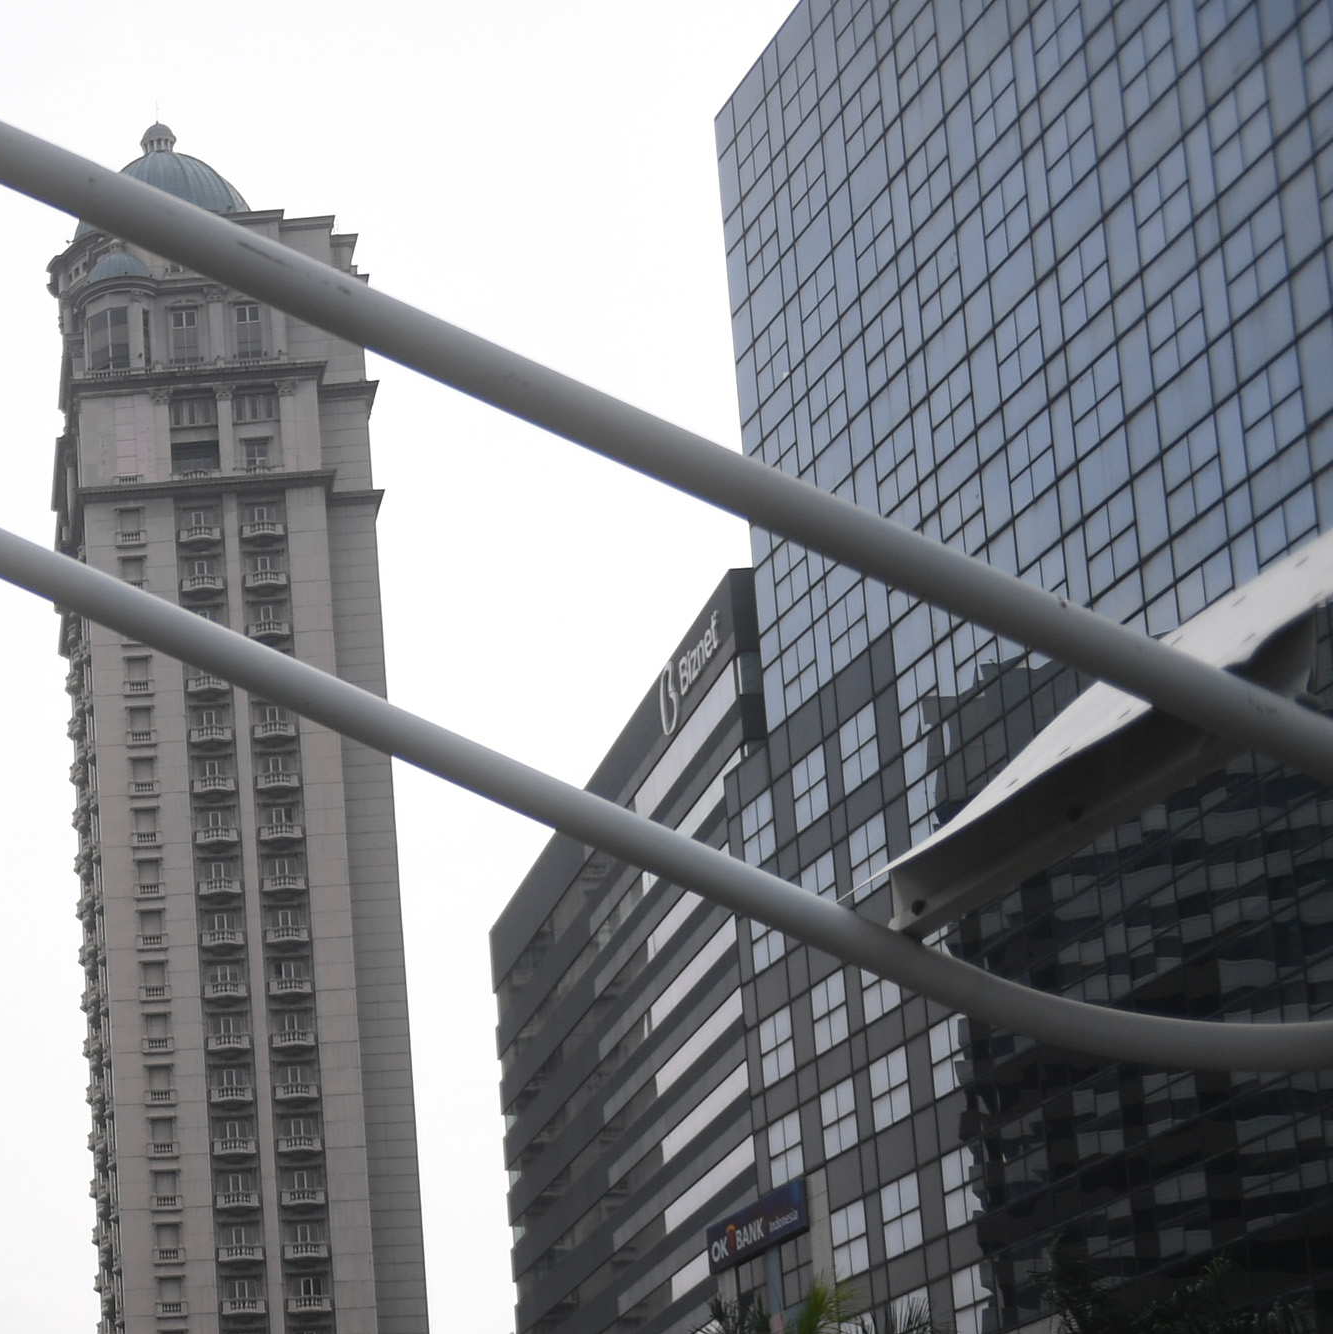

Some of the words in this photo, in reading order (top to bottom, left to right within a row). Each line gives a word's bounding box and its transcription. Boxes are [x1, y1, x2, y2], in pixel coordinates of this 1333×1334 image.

[678, 611, 719, 696] Biznet
[735, 1217, 764, 1251] BANK
[769, 1209, 799, 1233] Indonesia
